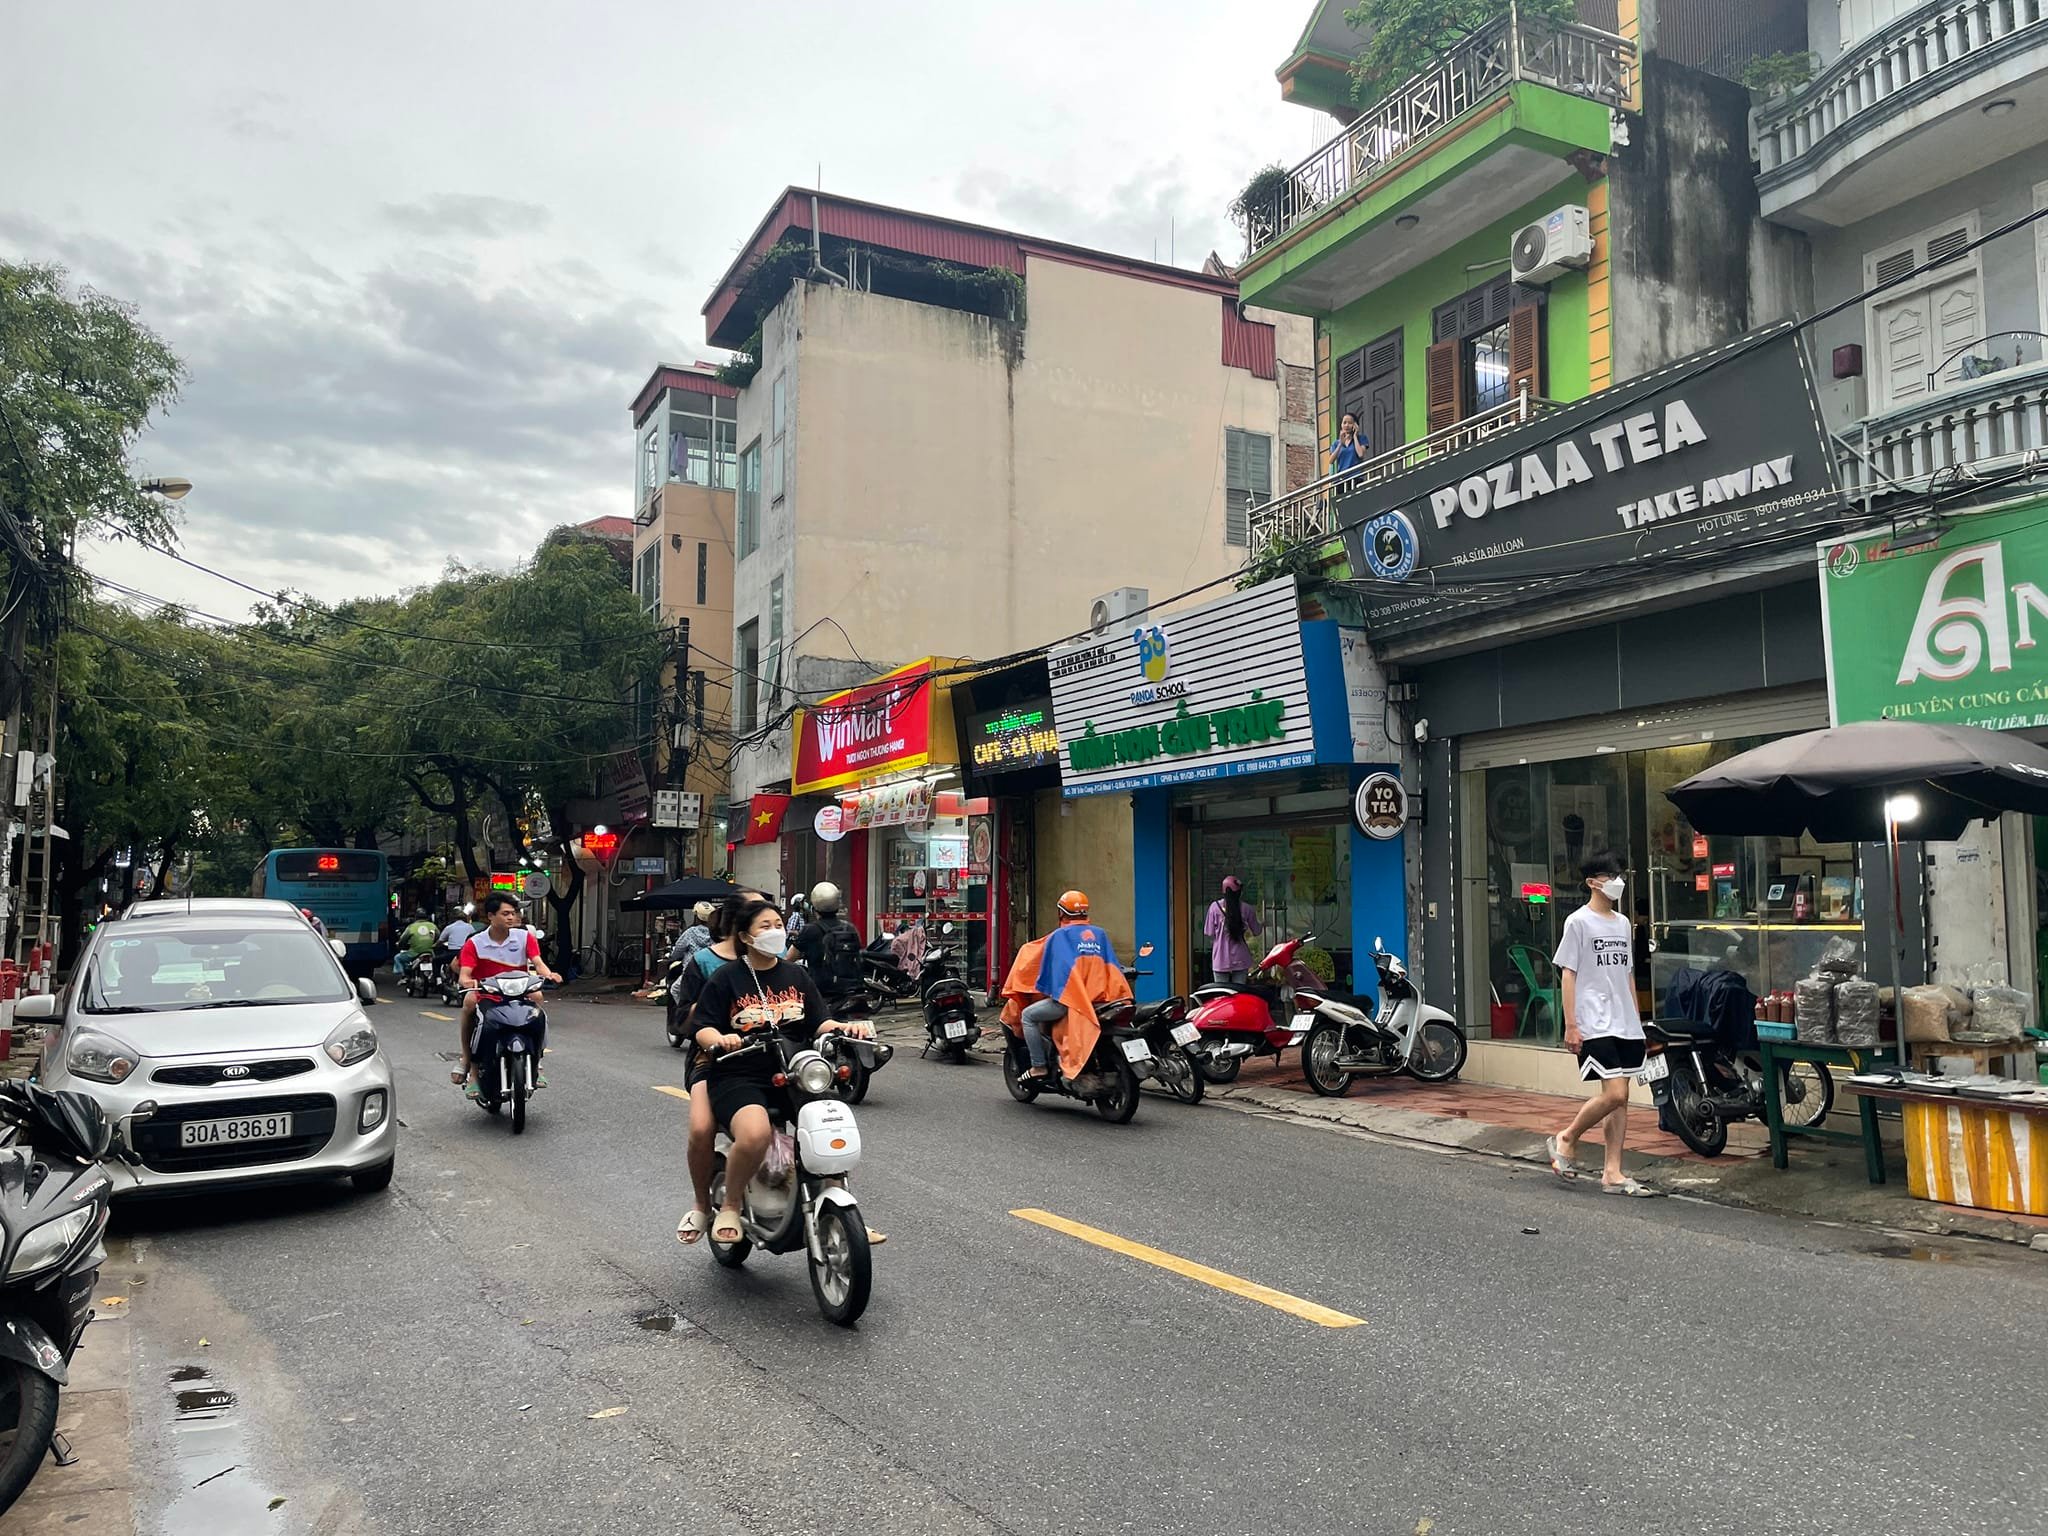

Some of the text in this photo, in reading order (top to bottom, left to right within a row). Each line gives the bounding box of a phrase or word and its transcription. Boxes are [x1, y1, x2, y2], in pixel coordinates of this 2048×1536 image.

[1430, 400, 1707, 529] POZAA TEA
[1617, 455, 1794, 529] TAKE AWAY
[1368, 516, 1399, 536] POZAA
[1502, 537, 1525, 553] LOAN
[1156, 681, 1186, 699] SCHOOL
[1882, 696, 1954, 718] CHUYÊN
[1959, 690, 2011, 709] CUNG
[1375, 787, 1393, 799] YO
[1371, 802, 1397, 813] TEA
[225, 1066, 246, 1076] KIA
[185, 1117, 287, 1145] 30A-836.91
